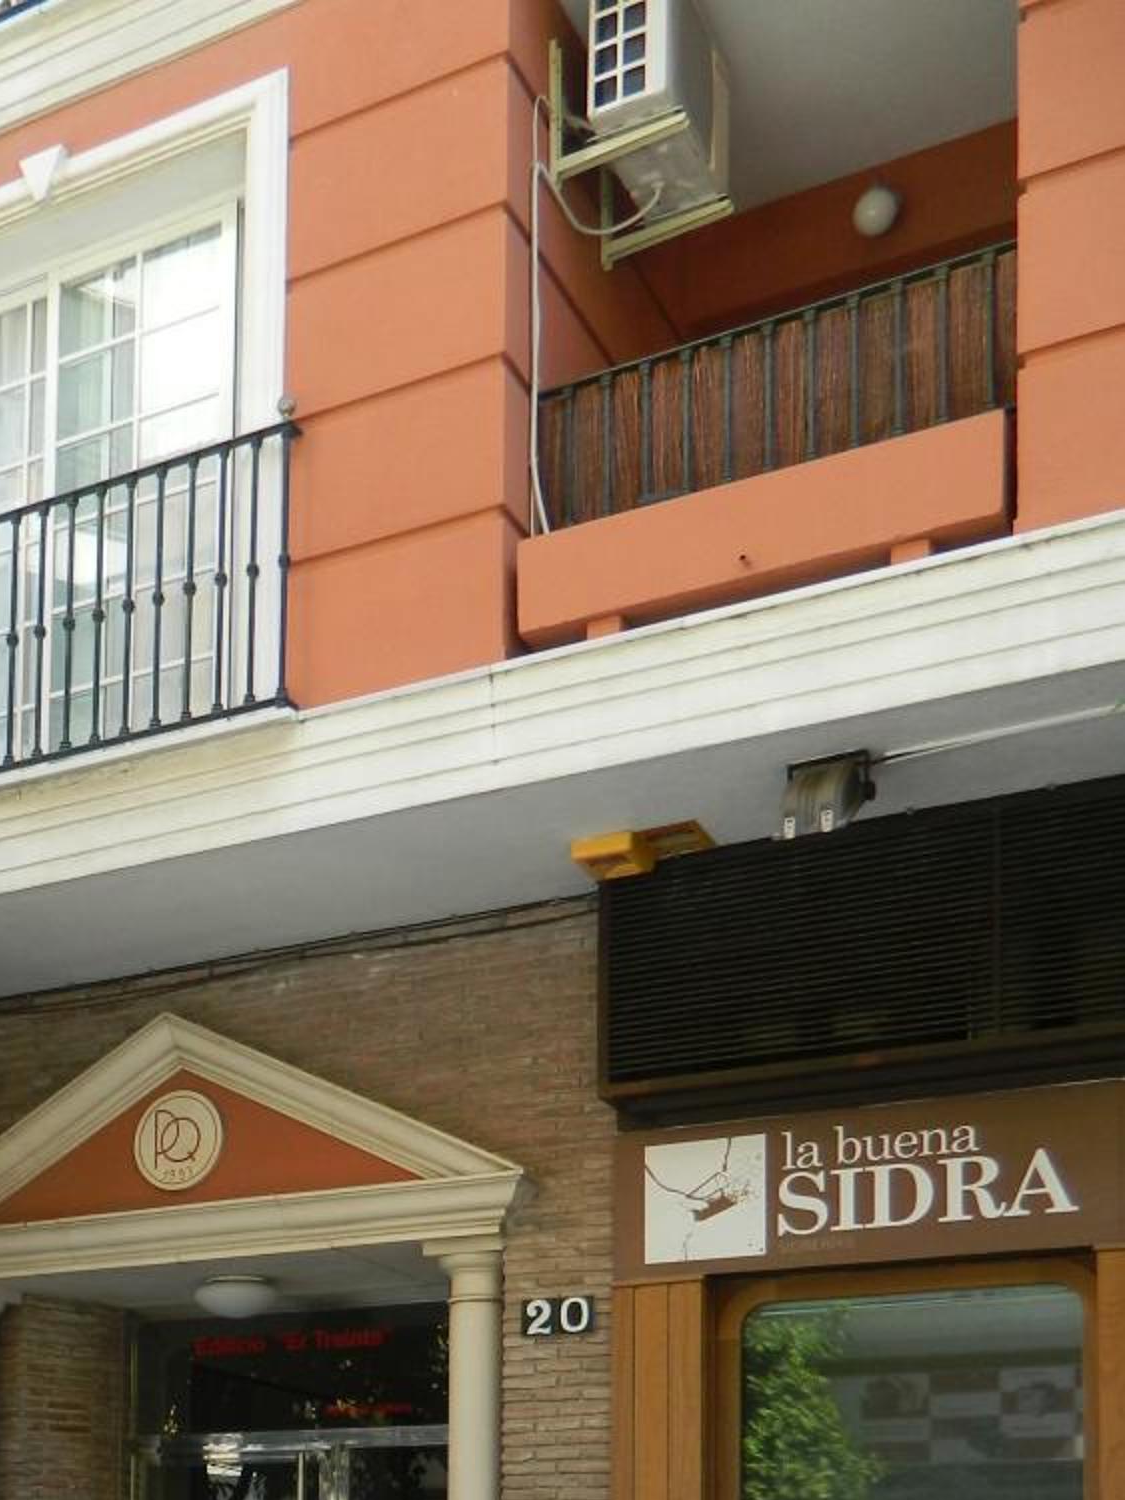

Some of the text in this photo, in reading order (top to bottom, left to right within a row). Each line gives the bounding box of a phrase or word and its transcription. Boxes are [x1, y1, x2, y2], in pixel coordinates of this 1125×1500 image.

[779, 1124, 980, 1171] la buena
[777, 1147, 1080, 1237] SIDRA
[526, 1297, 589, 1335] 20
